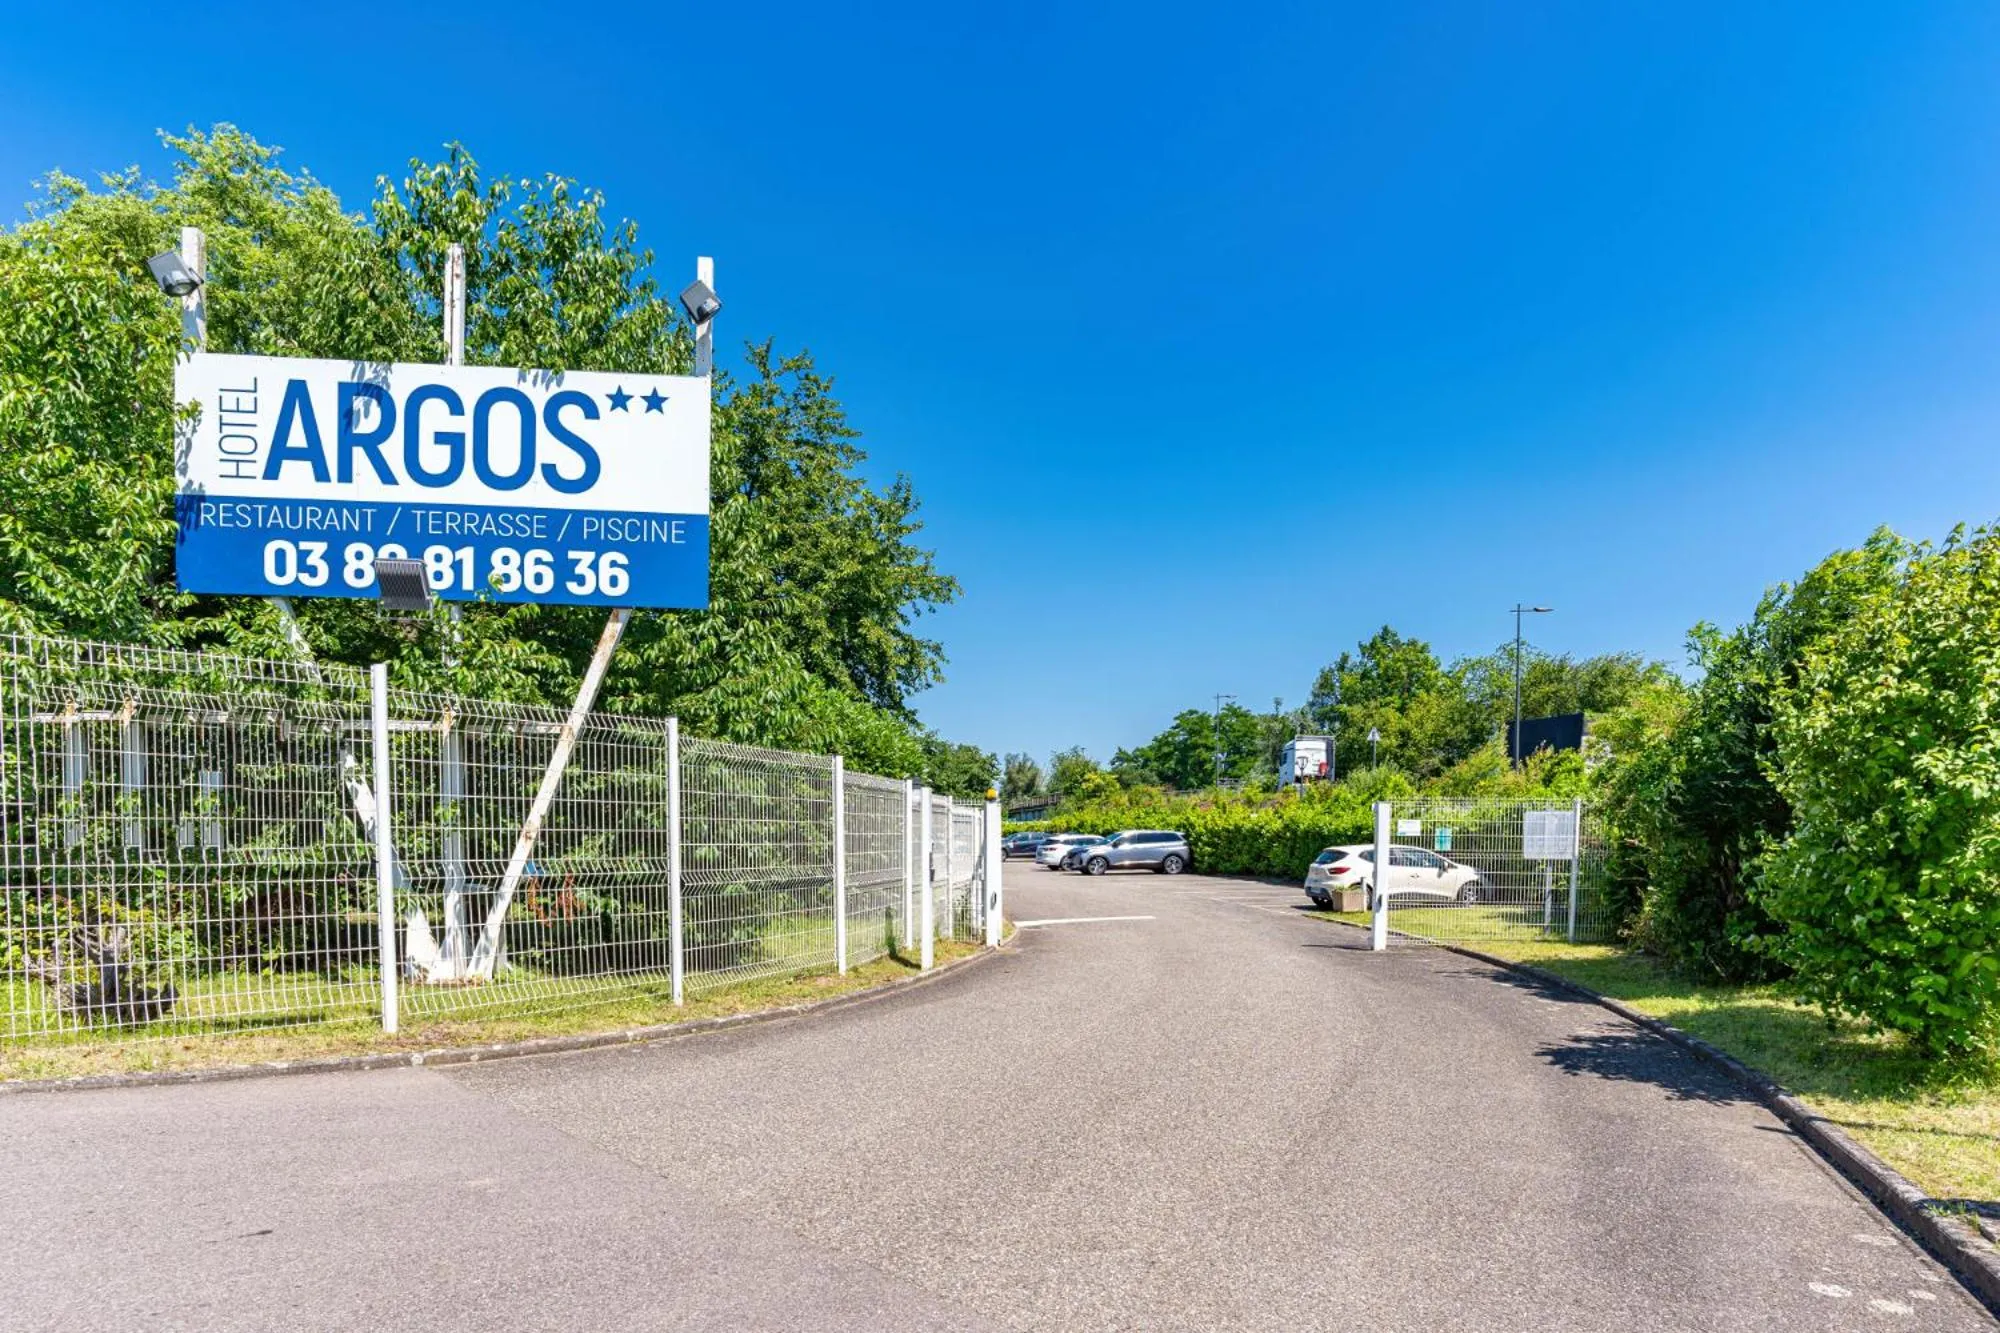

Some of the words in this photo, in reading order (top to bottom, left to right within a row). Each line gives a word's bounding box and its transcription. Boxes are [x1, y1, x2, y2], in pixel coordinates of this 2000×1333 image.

[219, 377, 258, 479] HOTEL
[262, 379, 601, 494] ARGOS
[200, 503, 377, 533] RESTAURANT
[386, 507, 401, 535] /
[412, 510, 547, 538] TERRASSE
[557, 513, 573, 542] /
[583, 517, 686, 544] PISCINE
[264, 539, 329, 587] 03
[423, 545, 475, 591] 81
[490, 547, 555, 595] 86
[565, 551, 630, 597] 36
